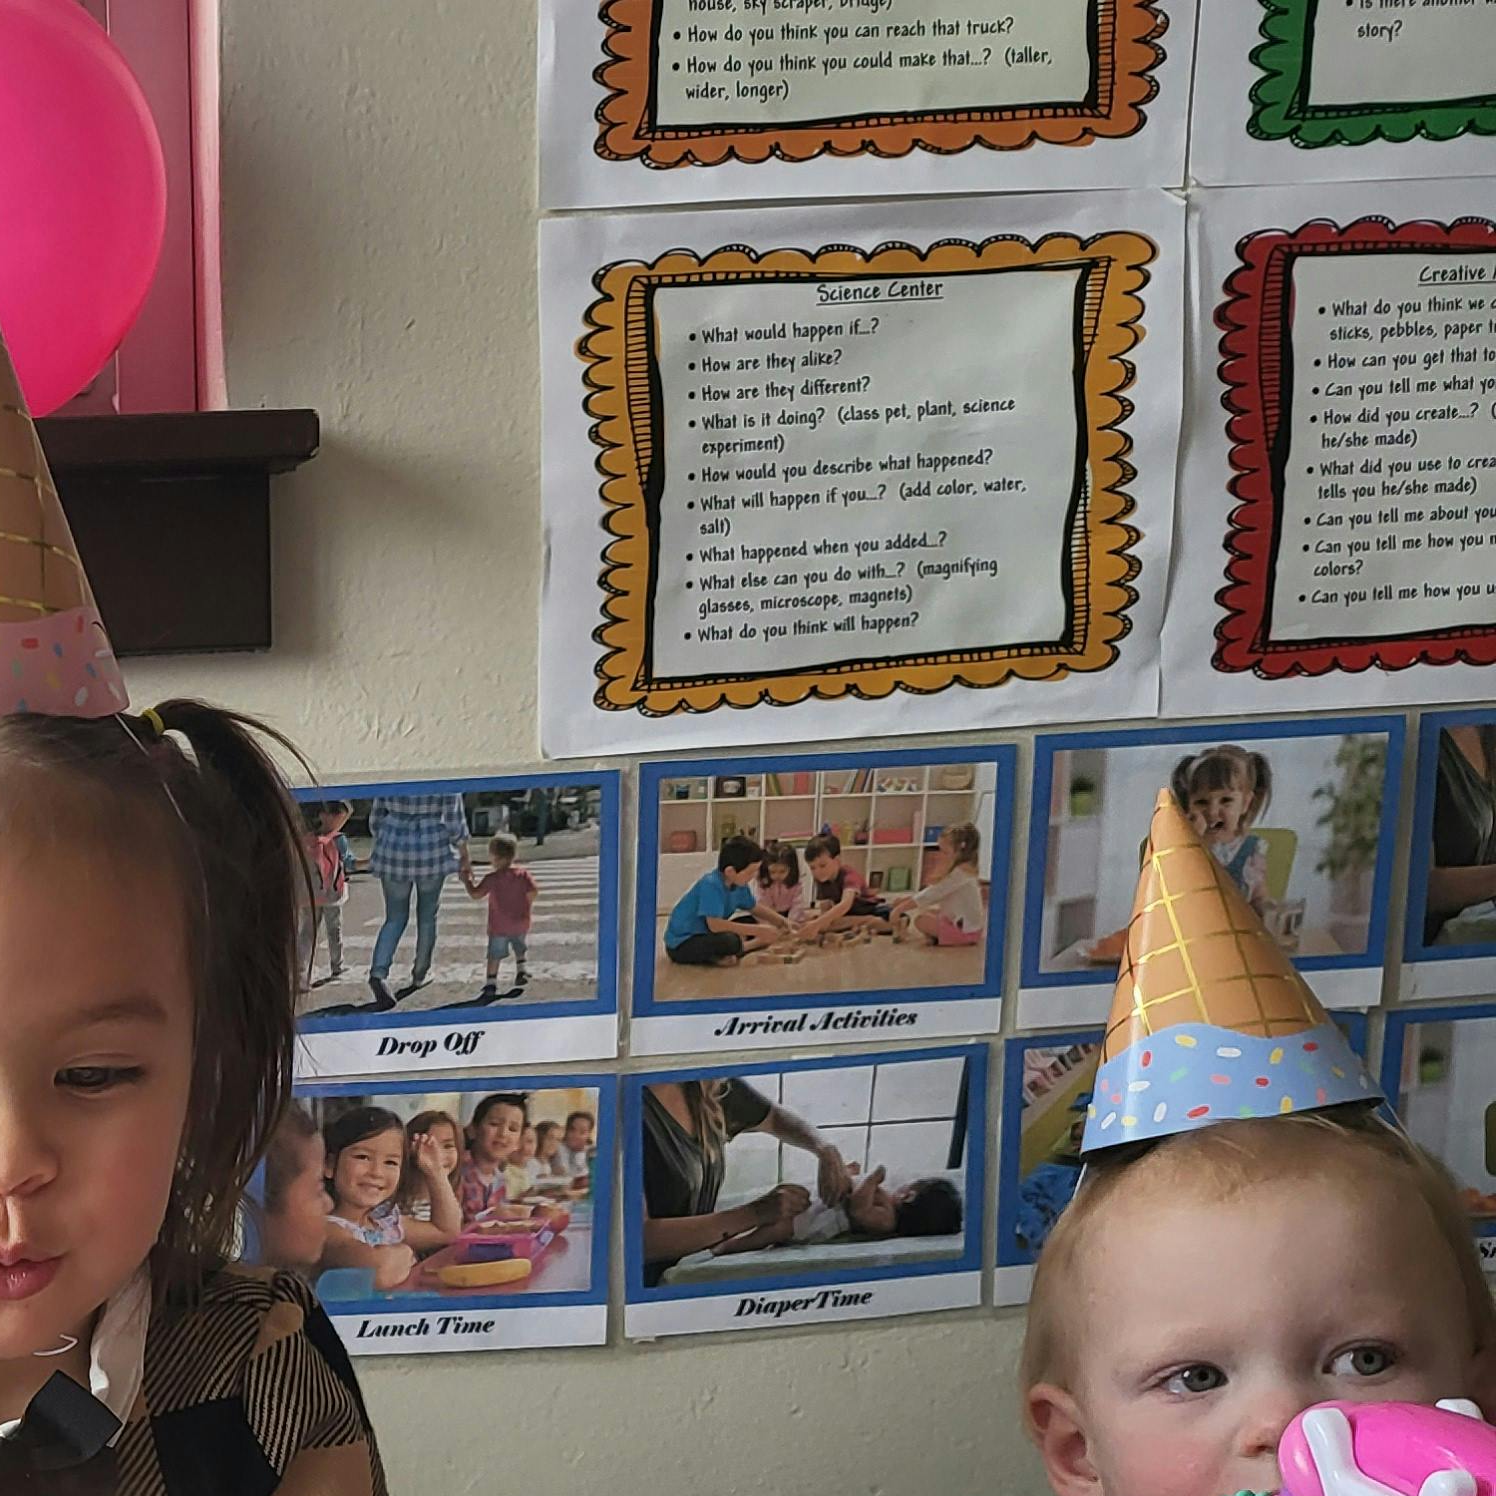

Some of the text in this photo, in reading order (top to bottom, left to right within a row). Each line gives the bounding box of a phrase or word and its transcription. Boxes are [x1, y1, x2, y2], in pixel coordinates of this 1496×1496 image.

[688, 17, 1013, 46] How do you think you can reach that truck?
[1357, 20, 1402, 42] story?
[687, 56, 716, 73] How
[723, 55, 741, 72] do
[748, 59, 773, 77] you
[780, 53, 816, 71] think
[822, 58, 846, 76] you
[853, 51, 892, 68] could
[899, 53, 936, 67] make
[1005, 46, 1052, 67] (taller,
[686, 79, 789, 103] wider, longer)
[1419, 264, 1487, 282] Creative
[817, 280, 943, 302] Science Center
[1332, 296, 1485, 319] What do you think we
[702, 327, 738, 344] What
[745, 323, 786, 340] would
[793, 322, 843, 343] happen
[1330, 321, 1483, 343] sticks, pebbles, paper
[702, 349, 842, 373] How are they alike?
[1328, 346, 1477, 371] How can you get that
[702, 376, 870, 402] How are they different?
[702, 399, 1015, 430] What is it doing? (class pet, plant, science
[1324, 409, 1351, 424] How
[1357, 407, 1379, 423] did
[1386, 411, 1410, 427] you
[702, 434, 784, 459] experiment)
[1322, 429, 1417, 448] he/she made)
[700, 574, 734, 591] What
[741, 572, 768, 588] else
[774, 574, 797, 585] can
[804, 572, 828, 589] you
[834, 566, 851, 581] do
[917, 557, 998, 580] (magnifying
[1314, 559, 1363, 576] colors?
[699, 584, 912, 620] glasses, microscope, magnets)
[698, 611, 919, 642] What do you think will happen?
[714, 1006, 919, 1038] Arrival Activities
[377, 1028, 486, 1062] Drop Off
[356, 1313, 496, 1340] Lunch Time
